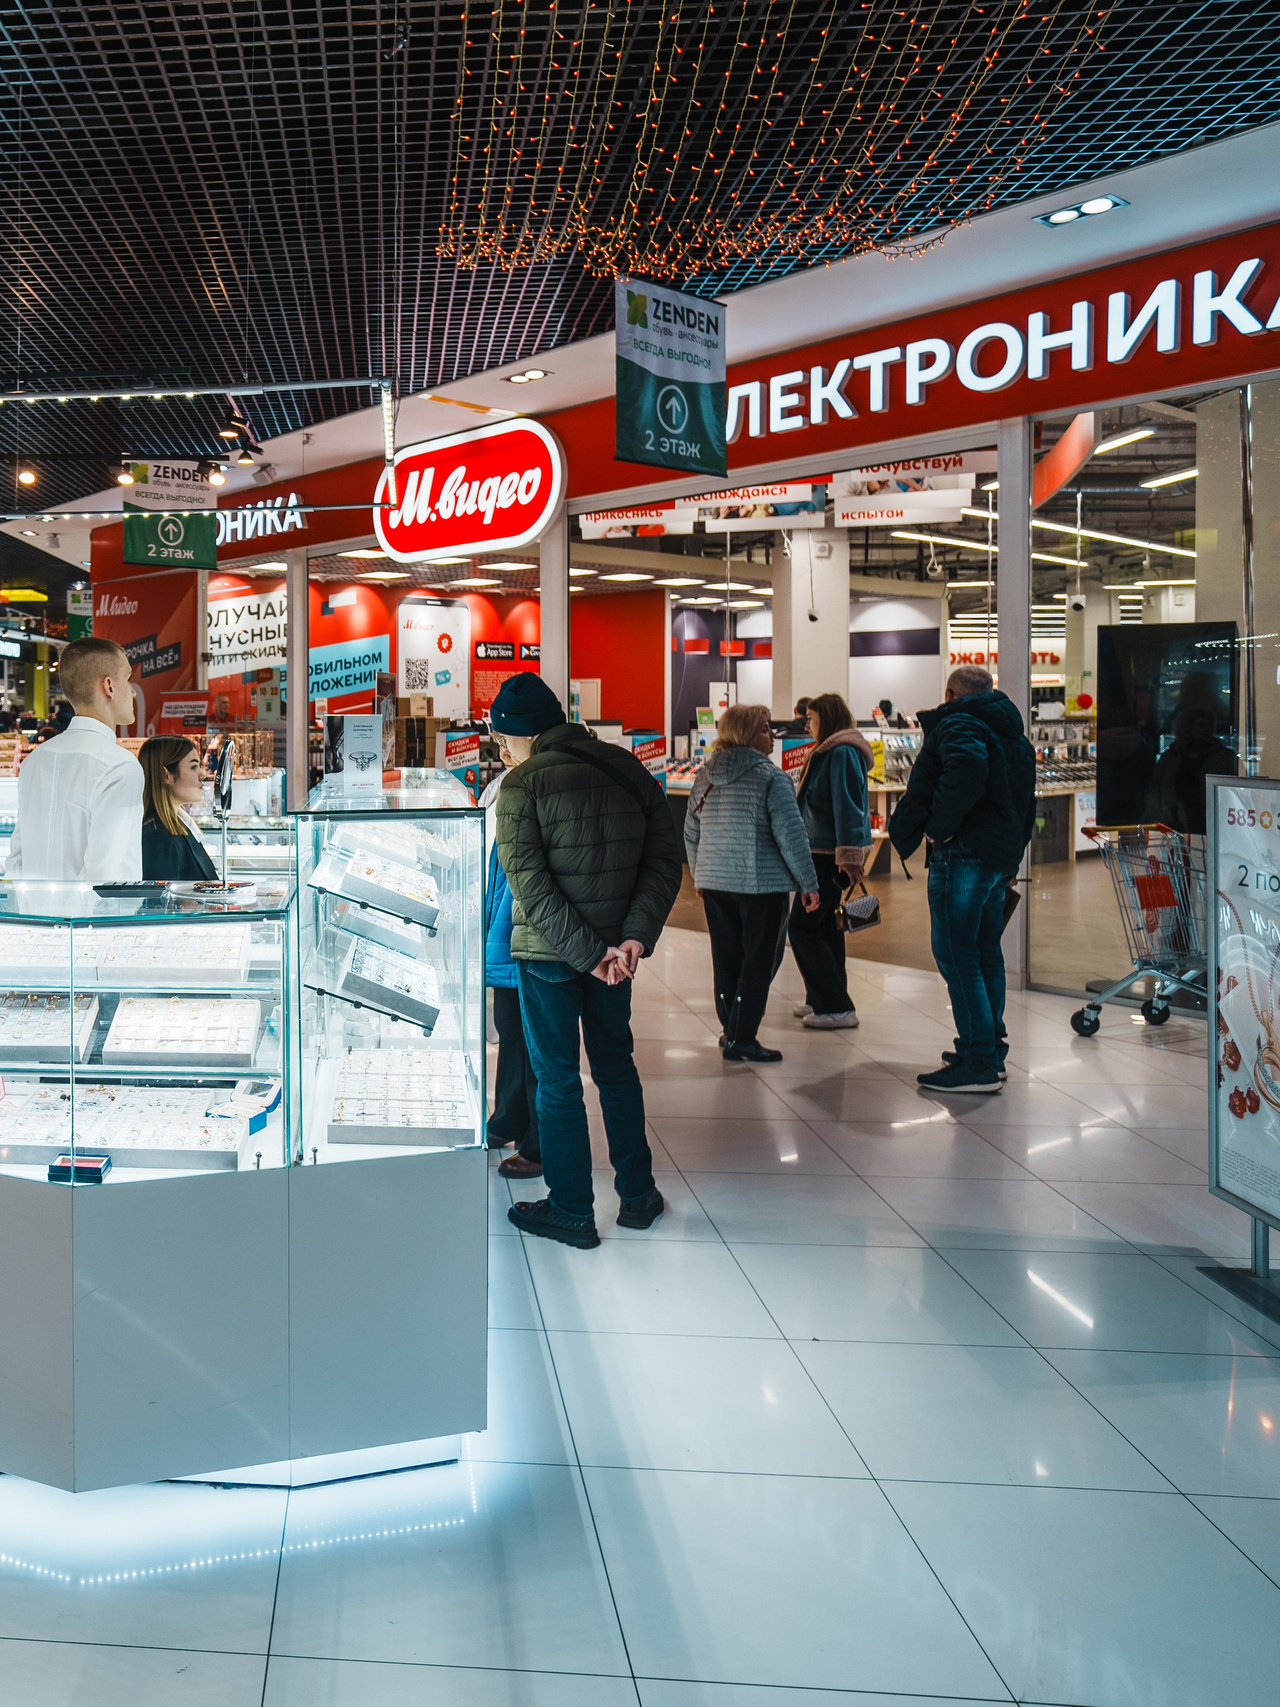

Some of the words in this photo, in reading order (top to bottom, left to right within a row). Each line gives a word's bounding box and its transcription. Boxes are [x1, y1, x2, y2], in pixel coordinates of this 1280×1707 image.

[651, 297, 719, 336] ZENDEN
[677, 329, 719, 349] аксессуары
[633, 338, 664, 358] ВСЕГДА
[667, 348, 711, 370] ВЫГОДНО!
[726, 256, 1280, 444] ЛЕКТРОНИК
[645, 430, 655, 451] 2
[660, 437, 701, 459] этаж
[135, 490, 164, 500] ВСЕГДА
[166, 494, 206, 504] ВЫГОДНО!
[388, 466, 542, 530] М.видео
[585, 507, 663, 522] прикоснись
[147, 544, 157, 557] 2
[160, 547, 195, 560] этаж
[487, 648, 499, 658] App
[499, 648, 513, 657] Store
[142, 658, 155, 673] НА
[1227, 807, 1256, 828] 585
[1237, 864, 1249, 888] 2
